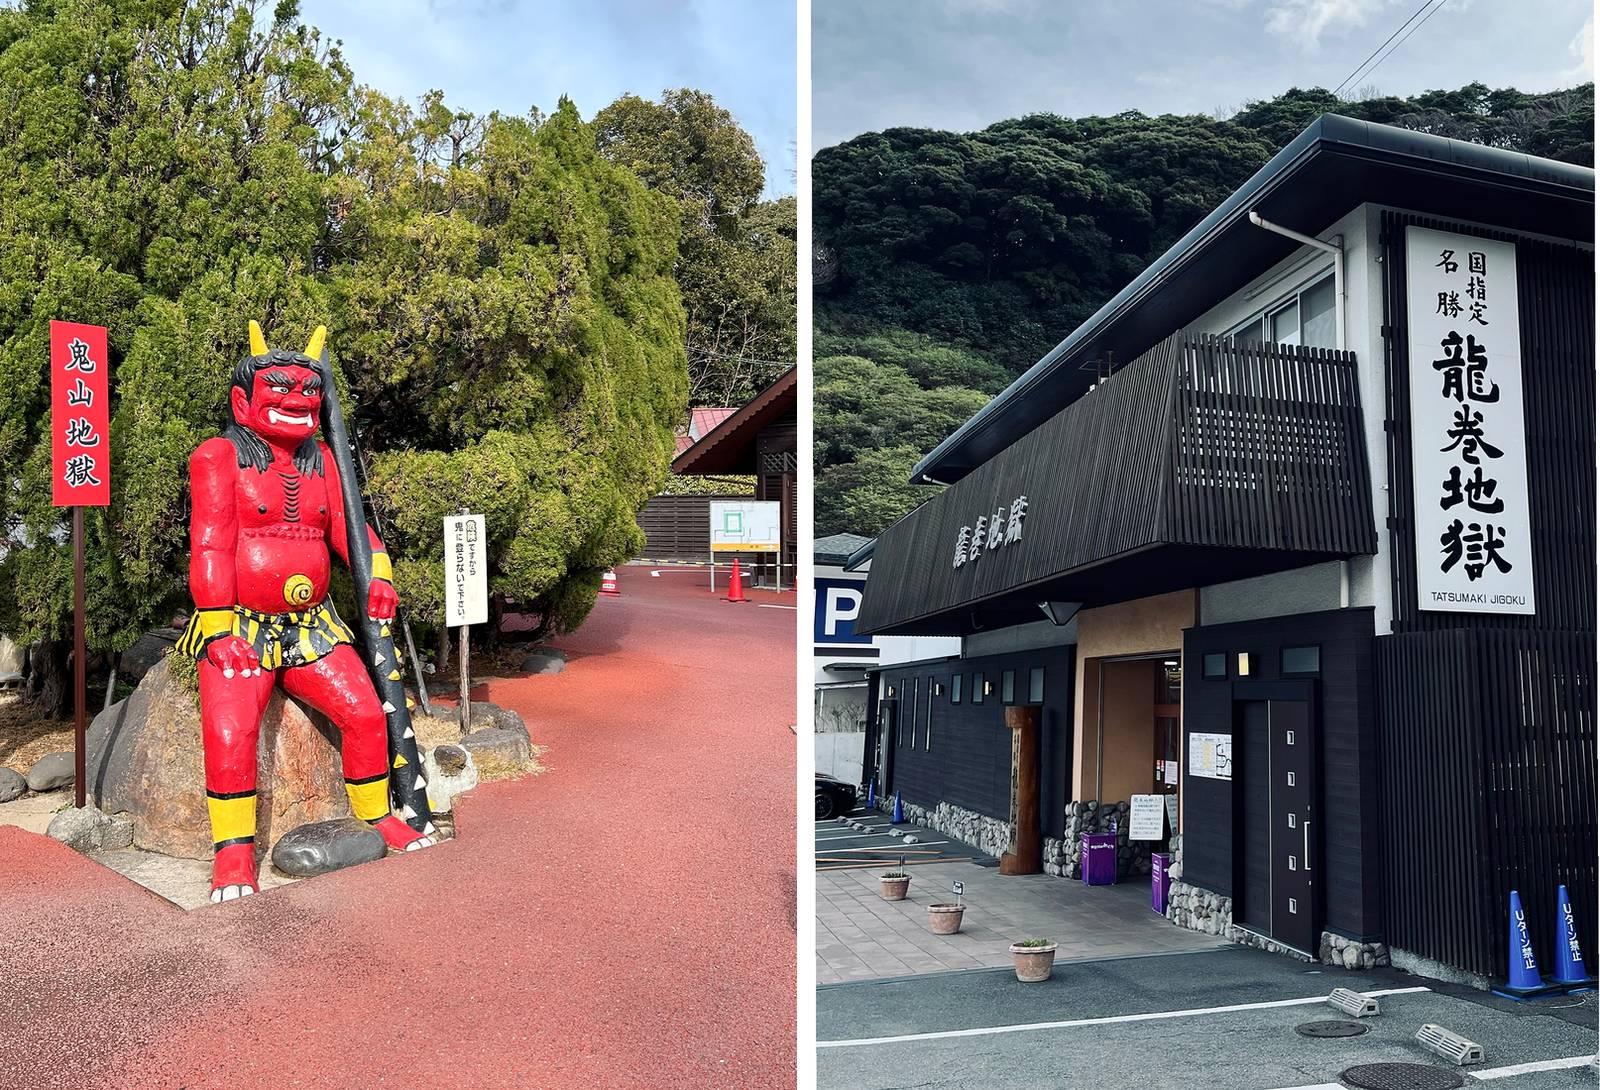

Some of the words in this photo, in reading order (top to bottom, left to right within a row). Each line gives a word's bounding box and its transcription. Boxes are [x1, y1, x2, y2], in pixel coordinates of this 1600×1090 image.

[1435, 249, 1464, 319] 名勝
[1466, 251, 1488, 326] 国指定
[64, 337, 101, 489] 鬼山地獄
[1432, 330, 1513, 582] 龍巻地獄
[824, 587, 863, 635] P
[1431, 592, 1487, 604] TATSUMAKI
[1490, 595, 1526, 606] JIGOKU
[1515, 909, 1536, 969] Uターン禁止
[1563, 903, 1582, 962] Uターン禁止
